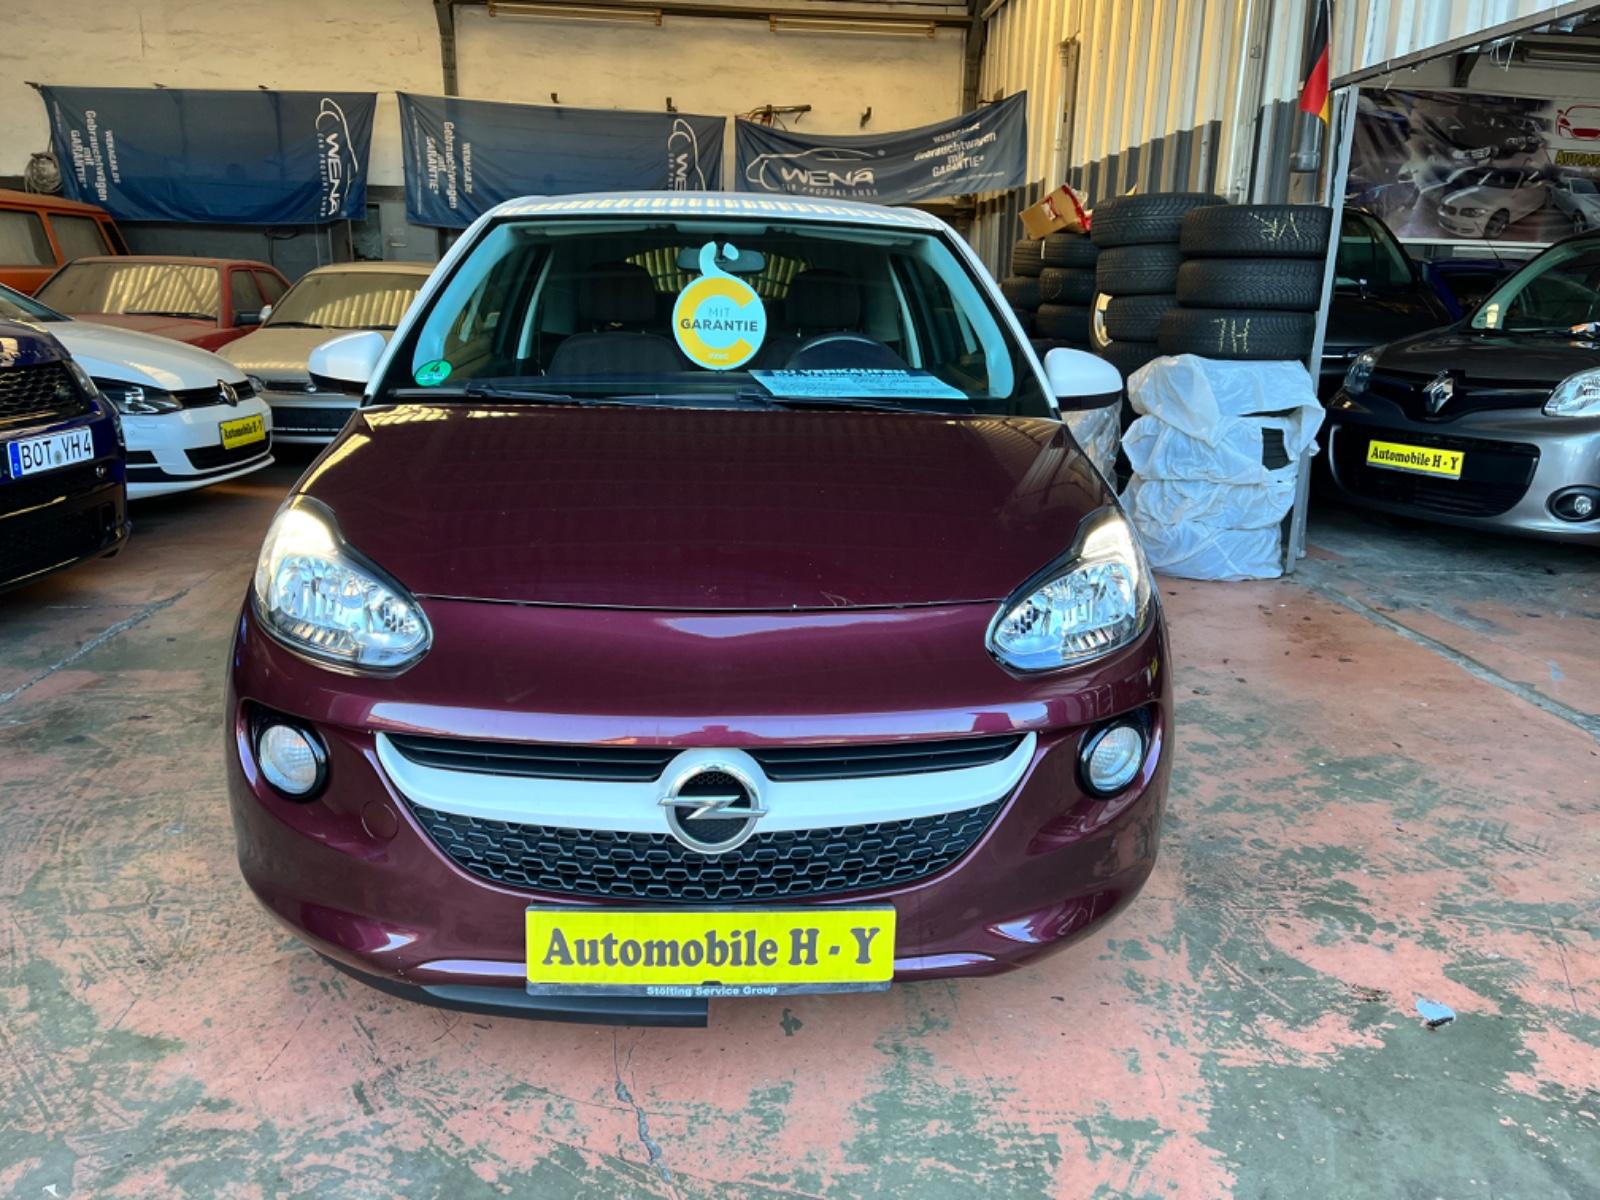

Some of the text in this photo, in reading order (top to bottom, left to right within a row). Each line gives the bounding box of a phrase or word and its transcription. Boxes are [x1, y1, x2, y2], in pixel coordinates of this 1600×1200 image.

[83, 146, 95, 166] mit
[85, 110, 108, 200] Gebrauchtwagen
[914, 132, 997, 161] brauchtwagen
[326, 132, 342, 215] WENA
[444, 121, 457, 209] Gebrauchtwagen
[781, 167, 875, 187] WENA
[708, 307, 730, 318] MIT
[680, 318, 758, 332] GARANTIE
[430, 361, 441, 372] 4
[21, 440, 52, 470] BOT
[1371, 446, 1431, 466] Automobile
[1432, 454, 1442, 468] H
[1450, 456, 1460, 470] Y
[542, 928, 779, 967] Automobile
[788, 928, 820, 965] H
[850, 927, 881, 964] Y
[646, 986, 778, 997] Stölting Service Group
